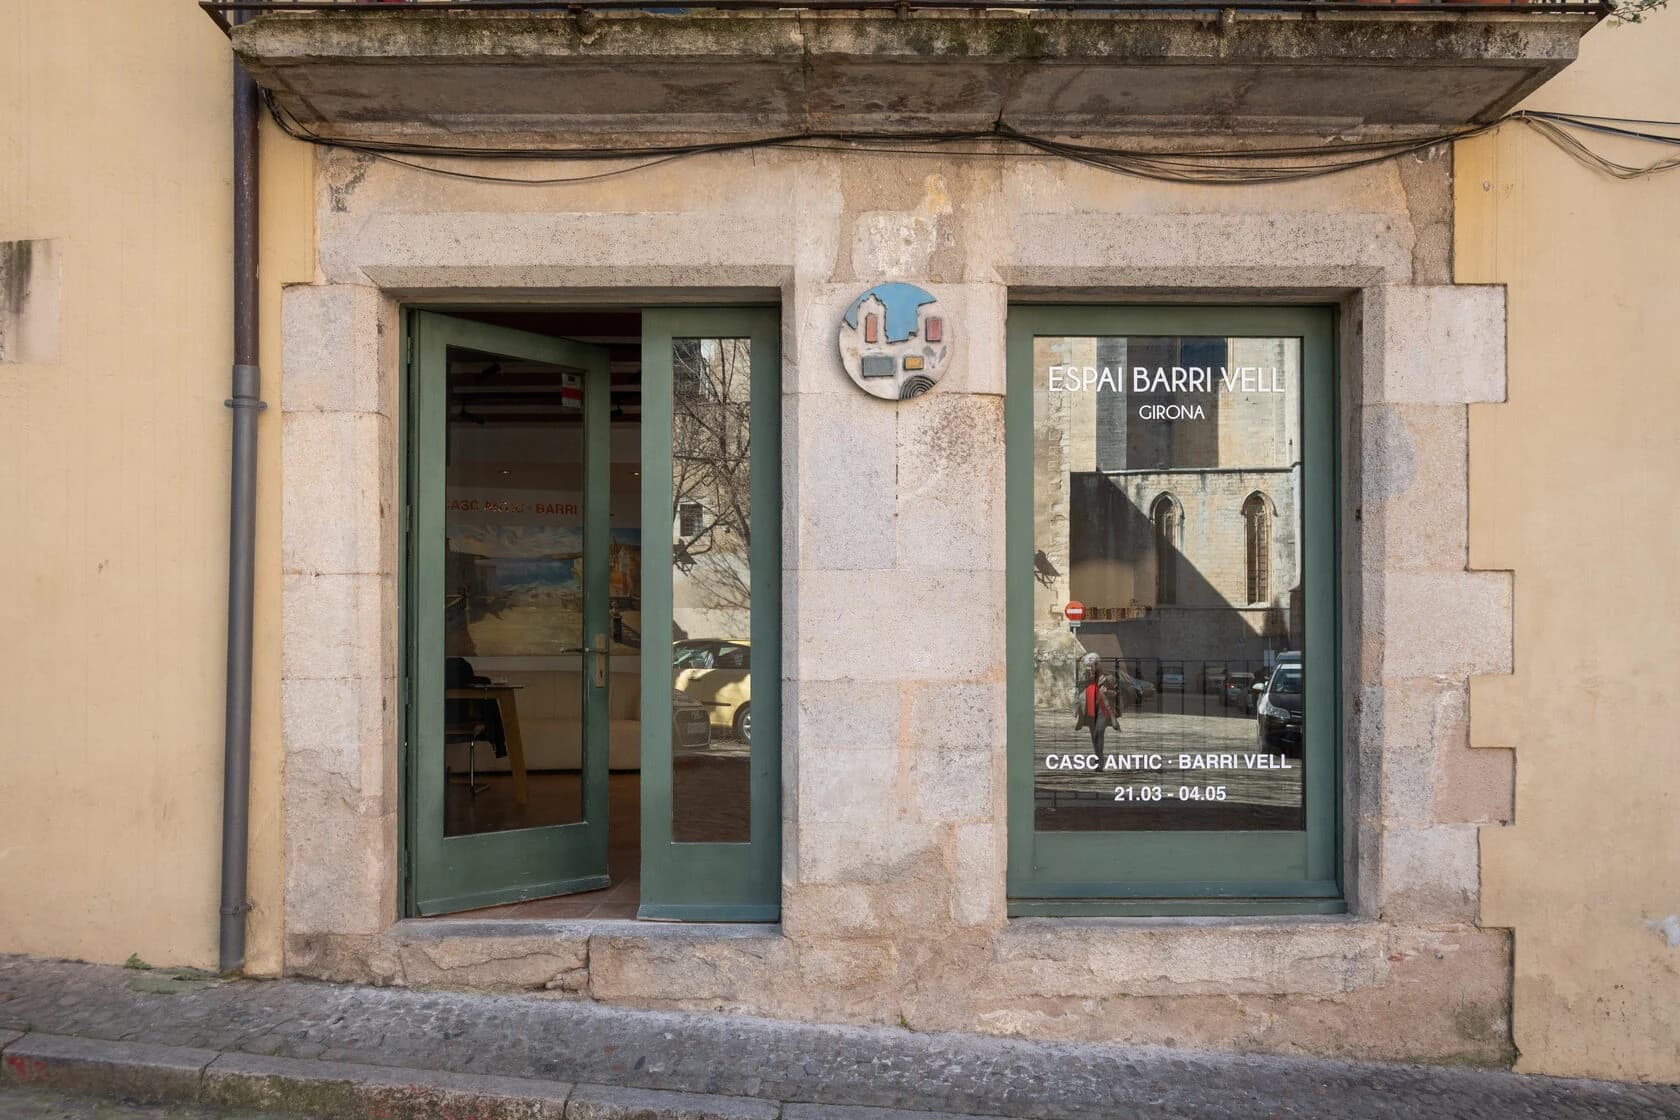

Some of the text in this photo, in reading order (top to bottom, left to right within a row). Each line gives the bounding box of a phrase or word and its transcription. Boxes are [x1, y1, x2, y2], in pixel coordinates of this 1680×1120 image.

[1049, 366, 1285, 393] ESPAI BARRI VELL
[1139, 404, 1205, 420] GIRONA
[447, 500, 479, 512] ASC
[535, 503, 578, 515] BARRI
[1045, 754, 1100, 770] CASC
[1104, 754, 1162, 770] ANTIC
[1178, 754, 1238, 769] BARRI
[1243, 753, 1292, 769] VELL
[1114, 786, 1162, 801] 21.03
[1178, 786, 1226, 801] 04.05
